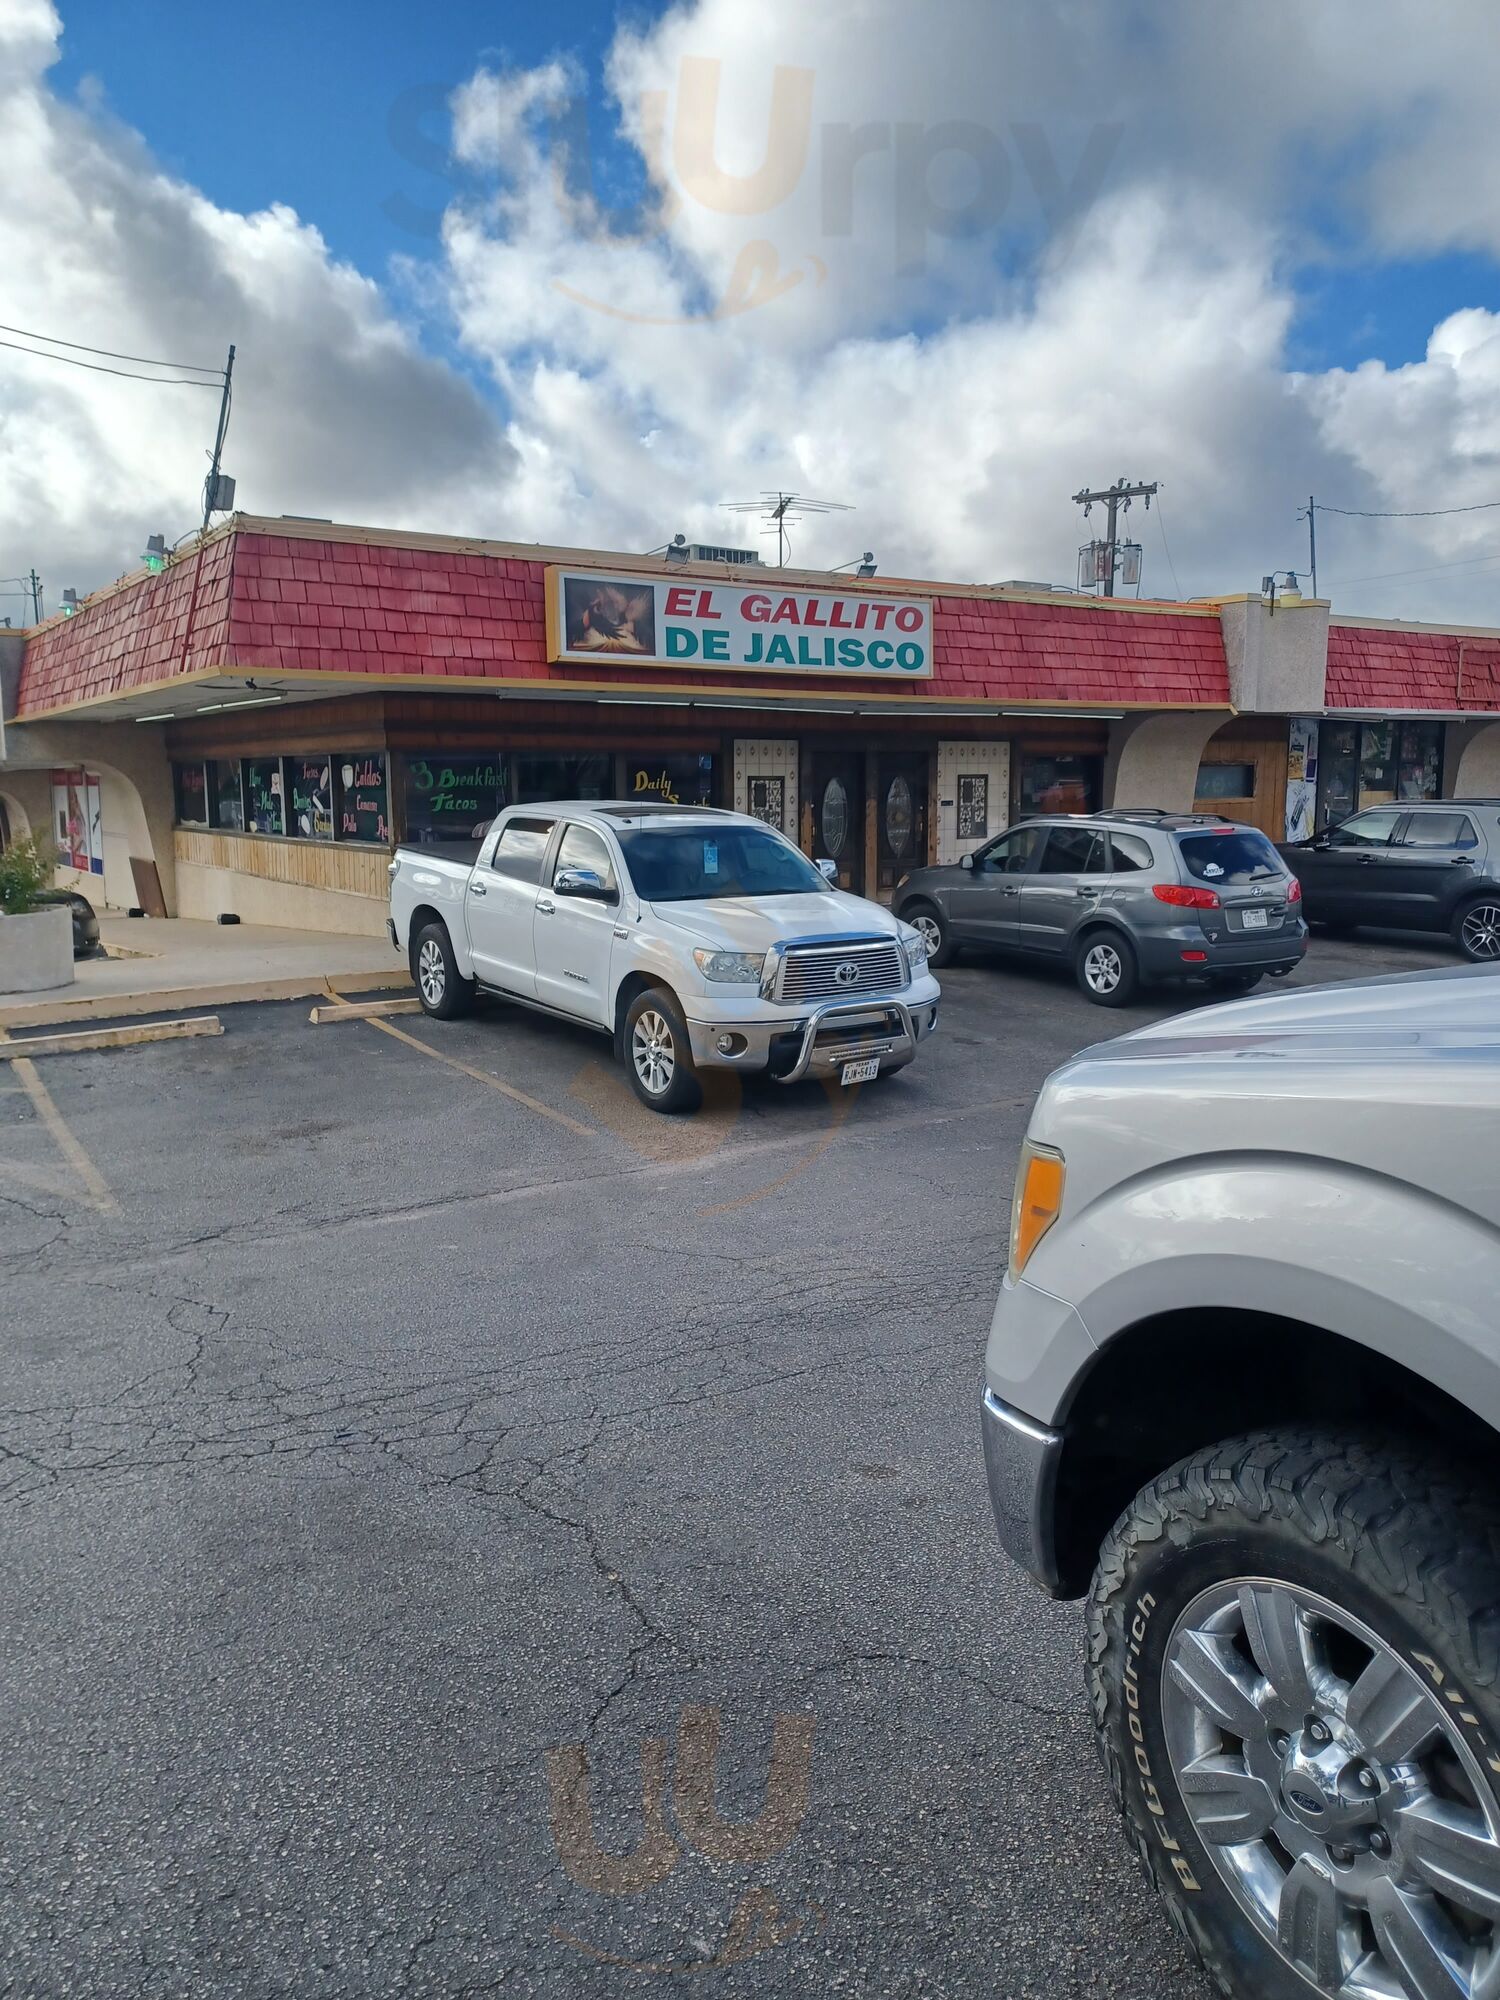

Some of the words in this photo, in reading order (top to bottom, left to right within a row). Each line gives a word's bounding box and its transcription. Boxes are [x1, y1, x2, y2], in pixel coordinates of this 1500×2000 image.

[664, 587, 722, 619] EL
[740, 594, 924, 633] GALLITO
[665, 626, 731, 661] DE
[743, 632, 925, 671] JALISCO
[410, 761, 435, 790] 3
[437, 766, 509, 789] Breakfast
[633, 770, 672, 798] Daily
[430, 793, 478, 812] Tacos
[1122, 1592, 1201, 1890] BFGoodrich
